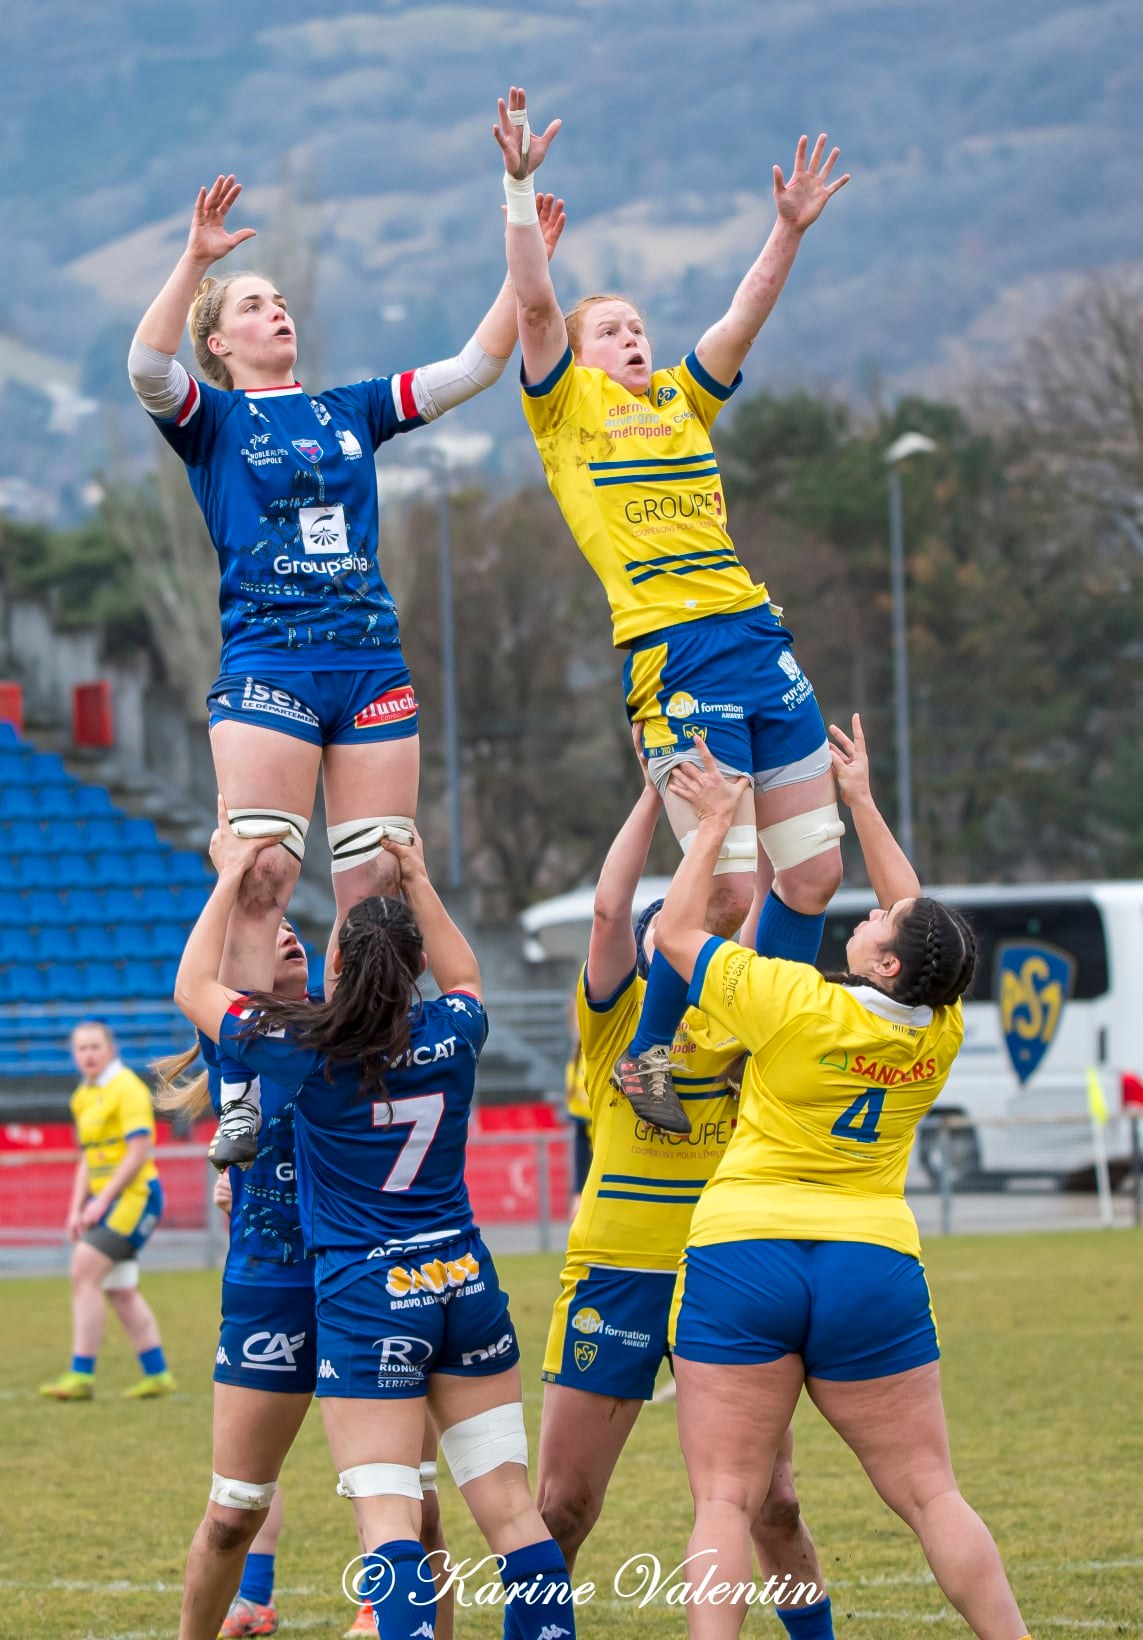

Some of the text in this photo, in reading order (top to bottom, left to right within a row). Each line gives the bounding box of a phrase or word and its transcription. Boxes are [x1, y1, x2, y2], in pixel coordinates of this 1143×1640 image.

[605, 413, 660, 427] auvergne
[609, 424, 672, 439] métropole
[624, 493, 715, 524] GROUPE
[701, 703, 744, 713] formation
[787, 702, 797, 711] LE
[851, 1055, 936, 1086] SANDERS
[831, 1088, 887, 1143] 4
[372, 1092, 445, 1191] 7
[390, 1297, 423, 1310] BRAVO,
[423, 1295, 435, 1306] LES
[465, 1281, 485, 1296] BLEU!
[605, 1324, 651, 1342] formation
